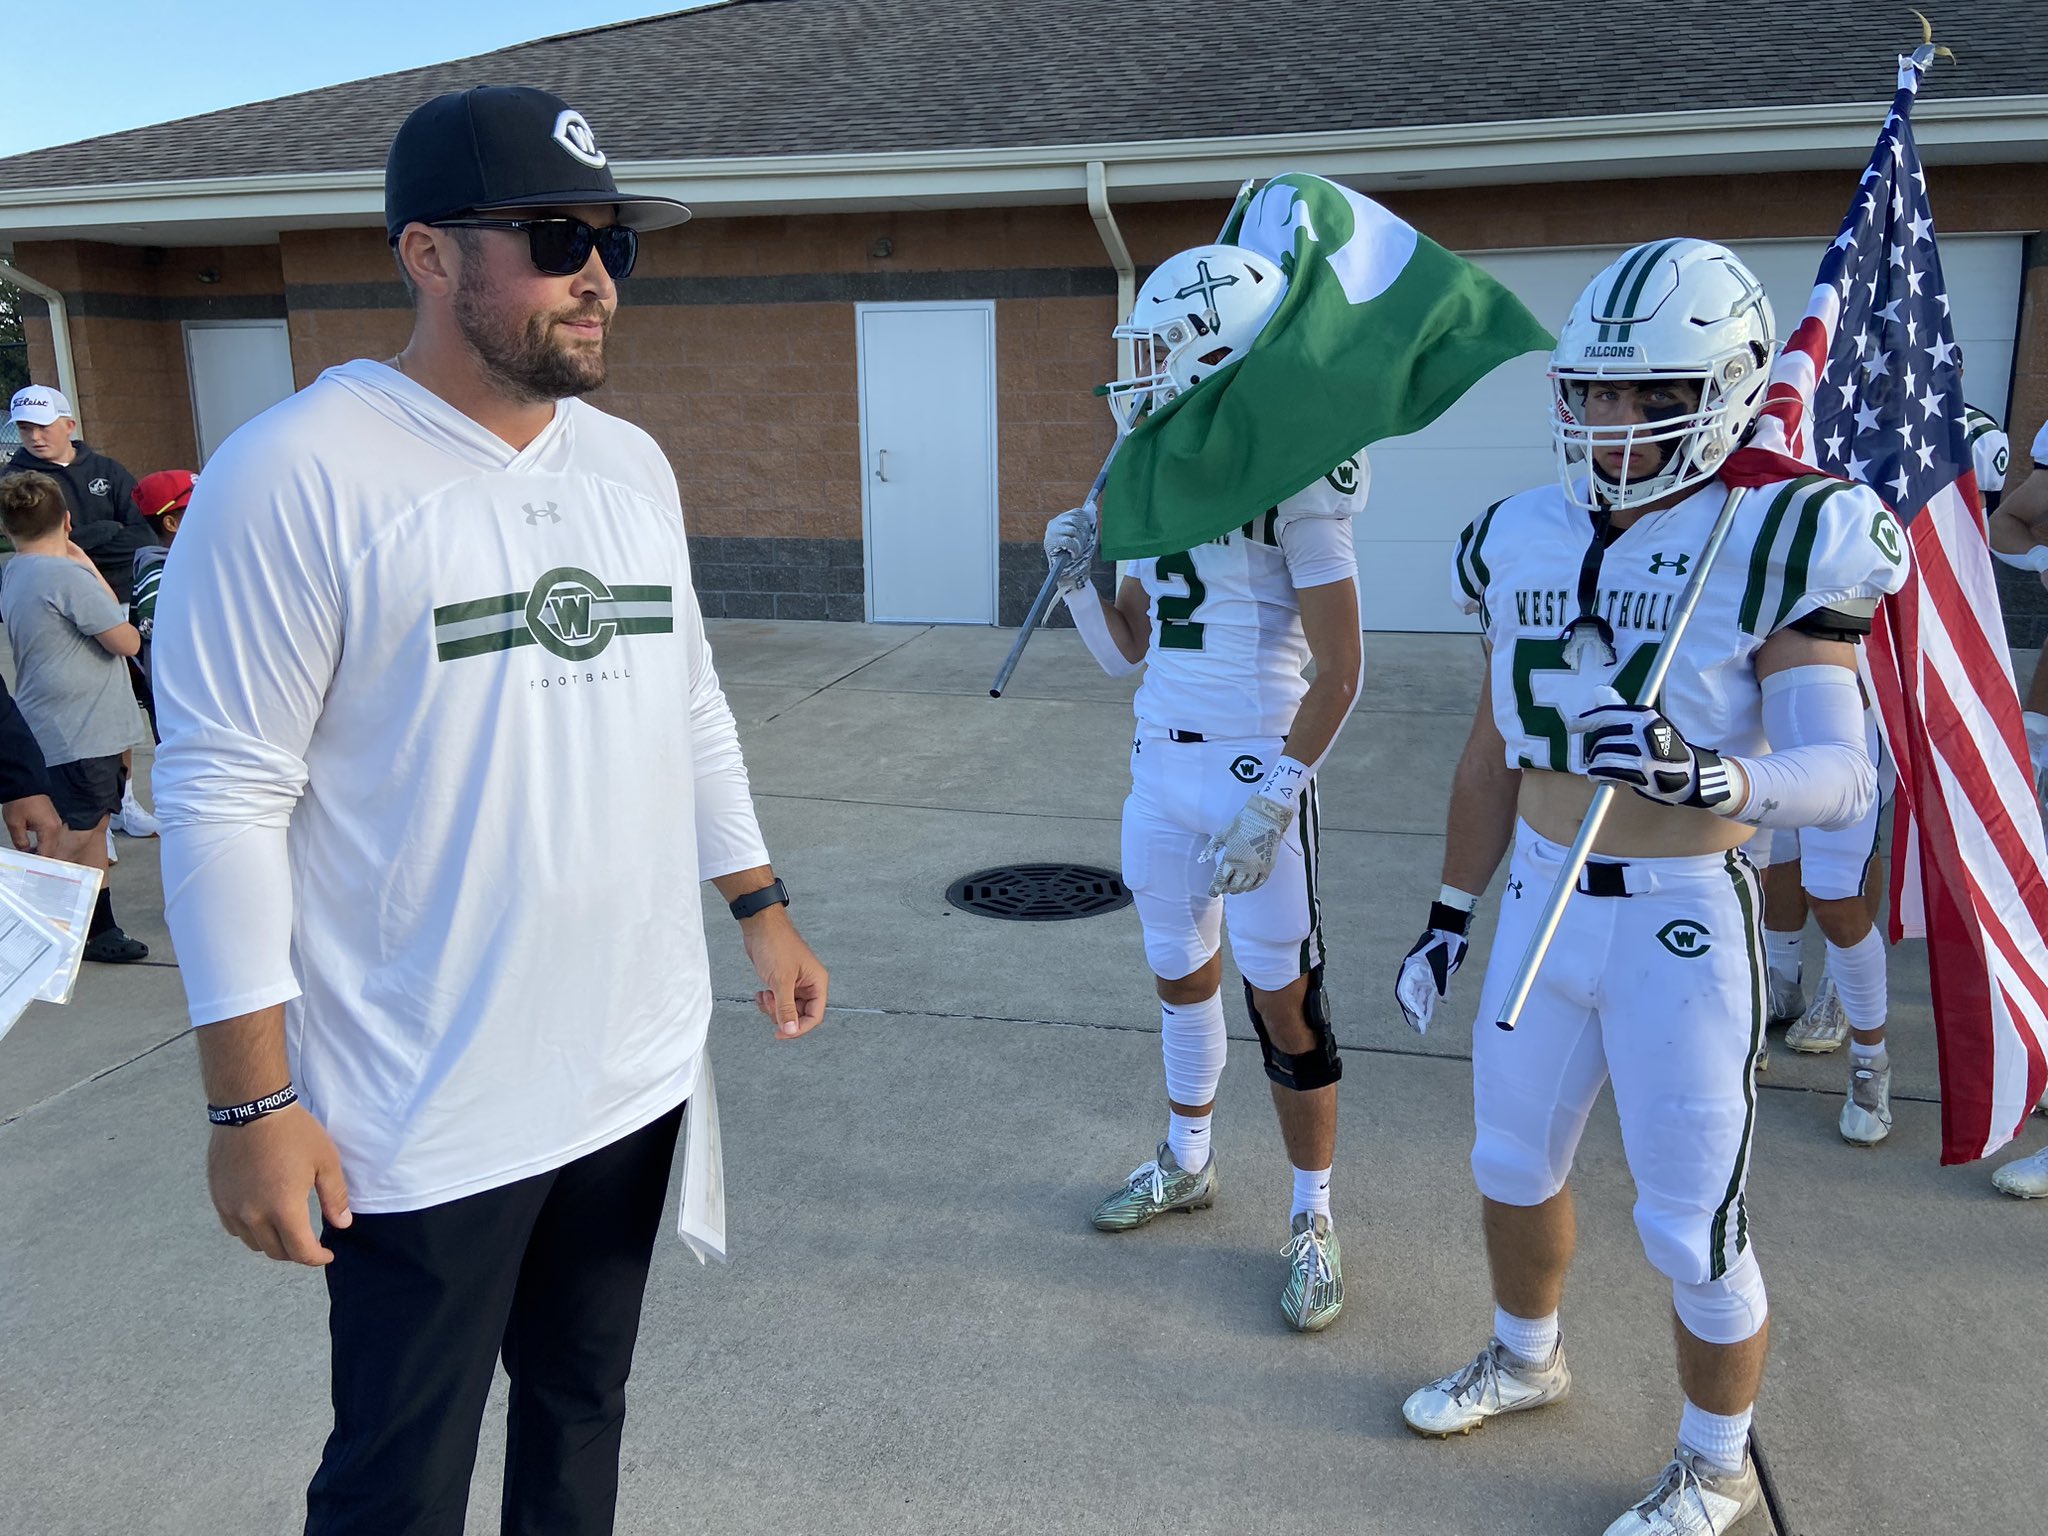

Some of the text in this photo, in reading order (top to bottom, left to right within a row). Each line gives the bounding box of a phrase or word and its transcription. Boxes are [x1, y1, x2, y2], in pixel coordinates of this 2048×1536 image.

[1584, 345, 1635, 358] FALCONS
[1155, 548, 1209, 653] 2
[1515, 589, 1570, 626] WEST
[530, 668, 631, 690] FOOTBALL
[232, 1103, 256, 1119] THE
[256, 1086, 295, 1112] PROCES
